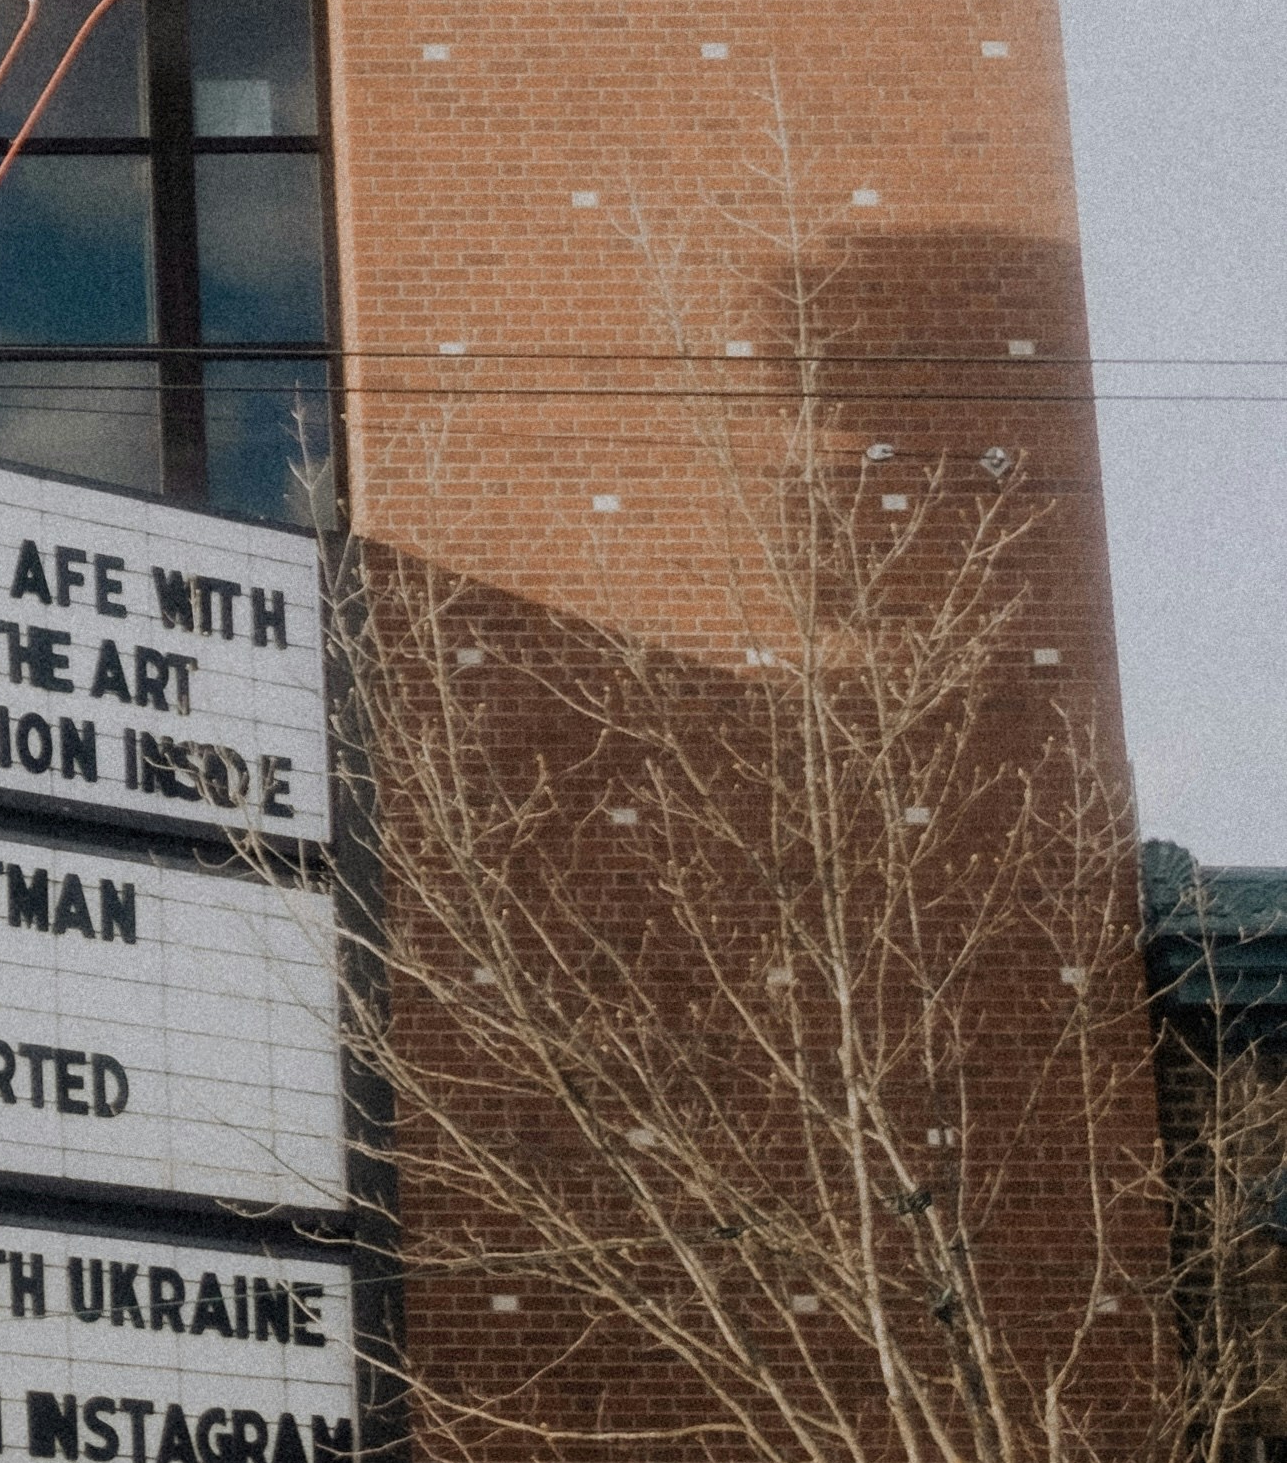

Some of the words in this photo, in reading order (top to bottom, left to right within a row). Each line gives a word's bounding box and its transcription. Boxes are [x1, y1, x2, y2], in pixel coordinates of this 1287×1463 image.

[151, 566, 287, 650] WITH
[91, 639, 198, 715] ART
[66, 1257, 328, 1348] UKRAINE
